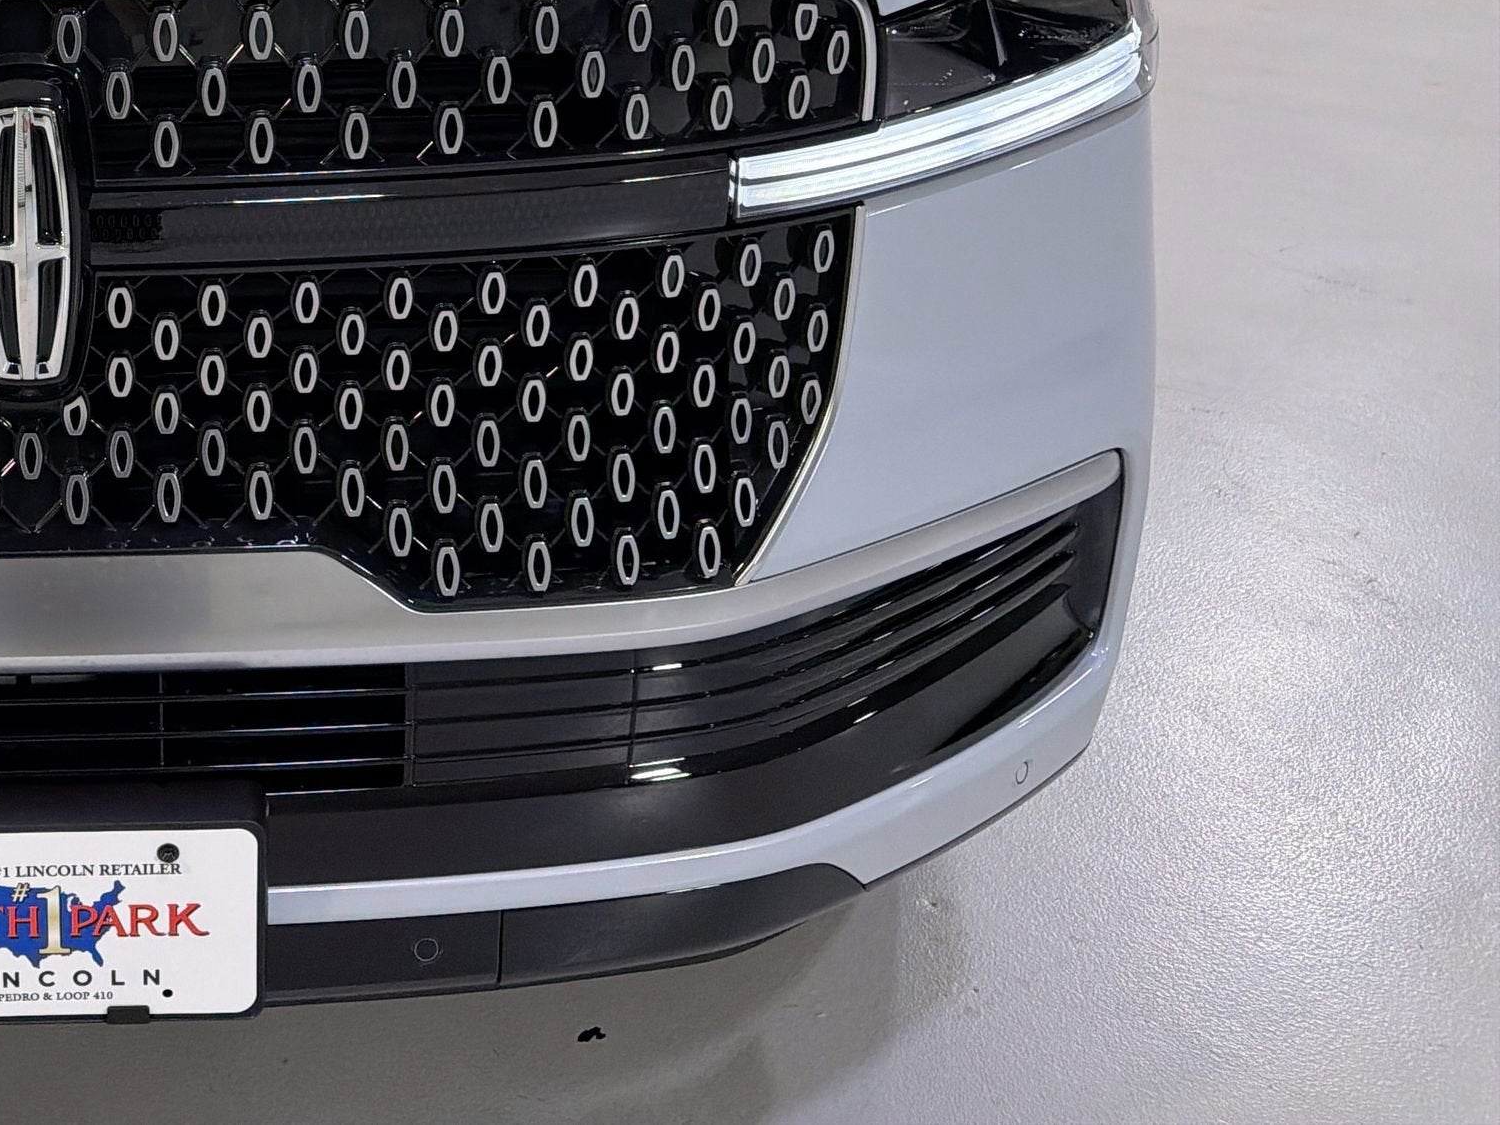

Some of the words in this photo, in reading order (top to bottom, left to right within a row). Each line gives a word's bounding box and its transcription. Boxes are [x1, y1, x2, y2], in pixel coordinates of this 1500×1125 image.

[15, 864, 95, 878] LINCOLN
[98, 862, 182, 876] RETAILER
[69, 903, 211, 938] PARK
[43, 992, 52, 1001] &
[56, 991, 91, 1001] LOOP
[92, 991, 114, 1001] 410
